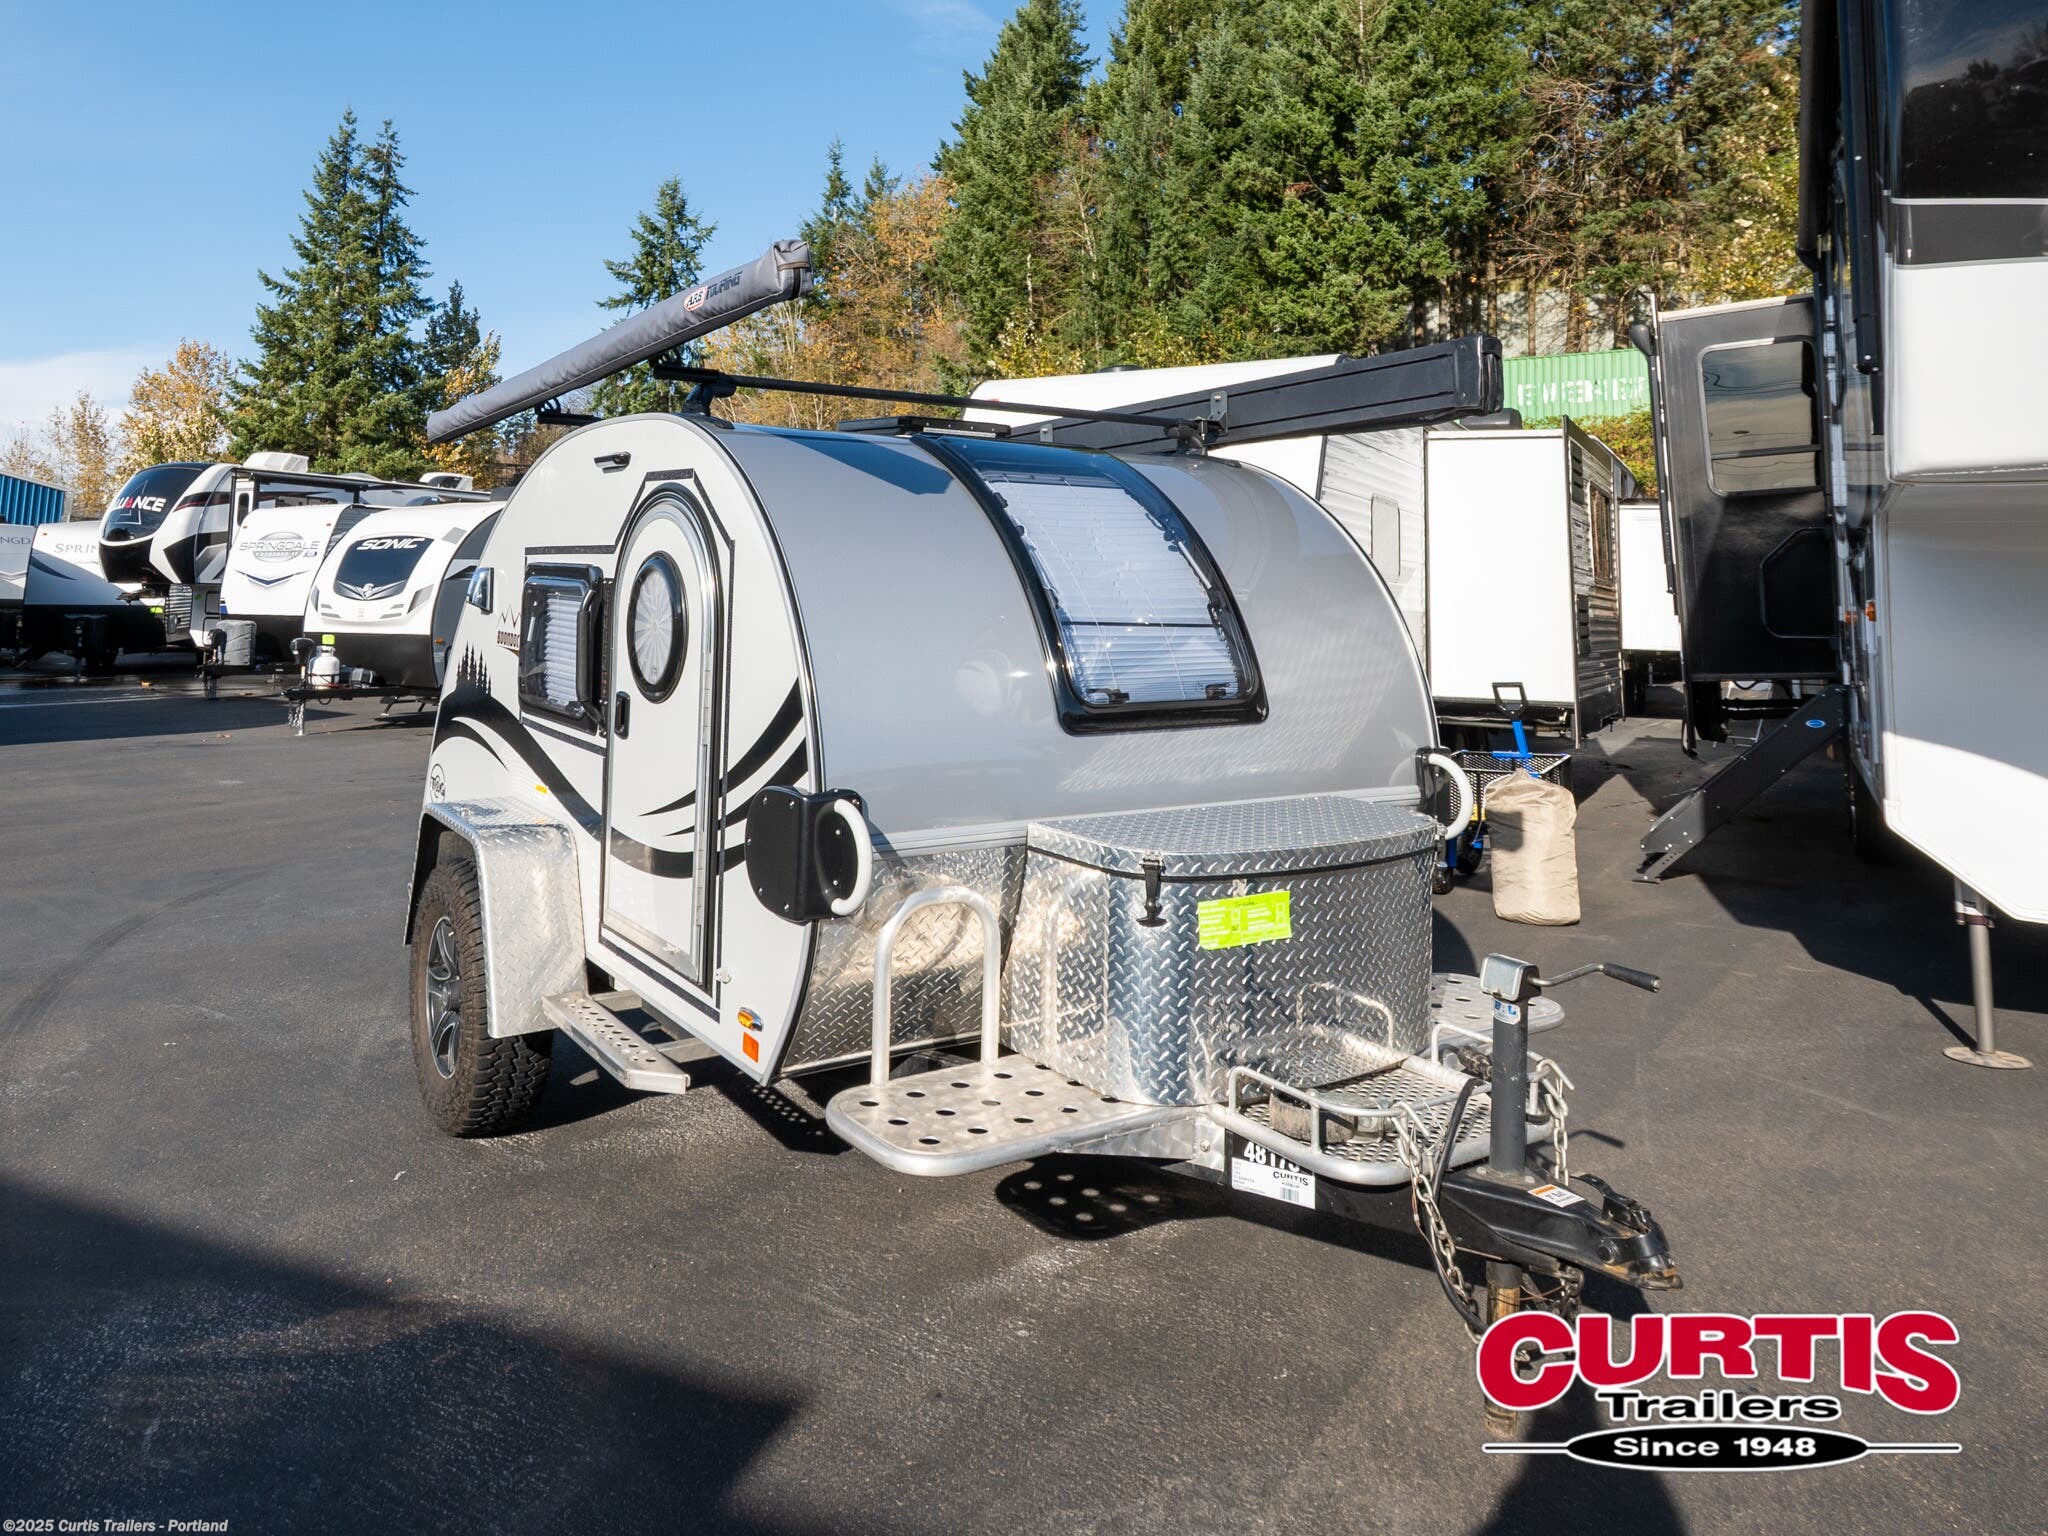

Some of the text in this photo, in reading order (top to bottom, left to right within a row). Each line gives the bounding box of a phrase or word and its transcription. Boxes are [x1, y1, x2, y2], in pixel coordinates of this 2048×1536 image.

[706, 270, 744, 300] TOURING
[239, 540, 320, 551] SPRINGDALE
[356, 537, 426, 551] SONIC
[1272, 1171, 1309, 1187] CURTIS
